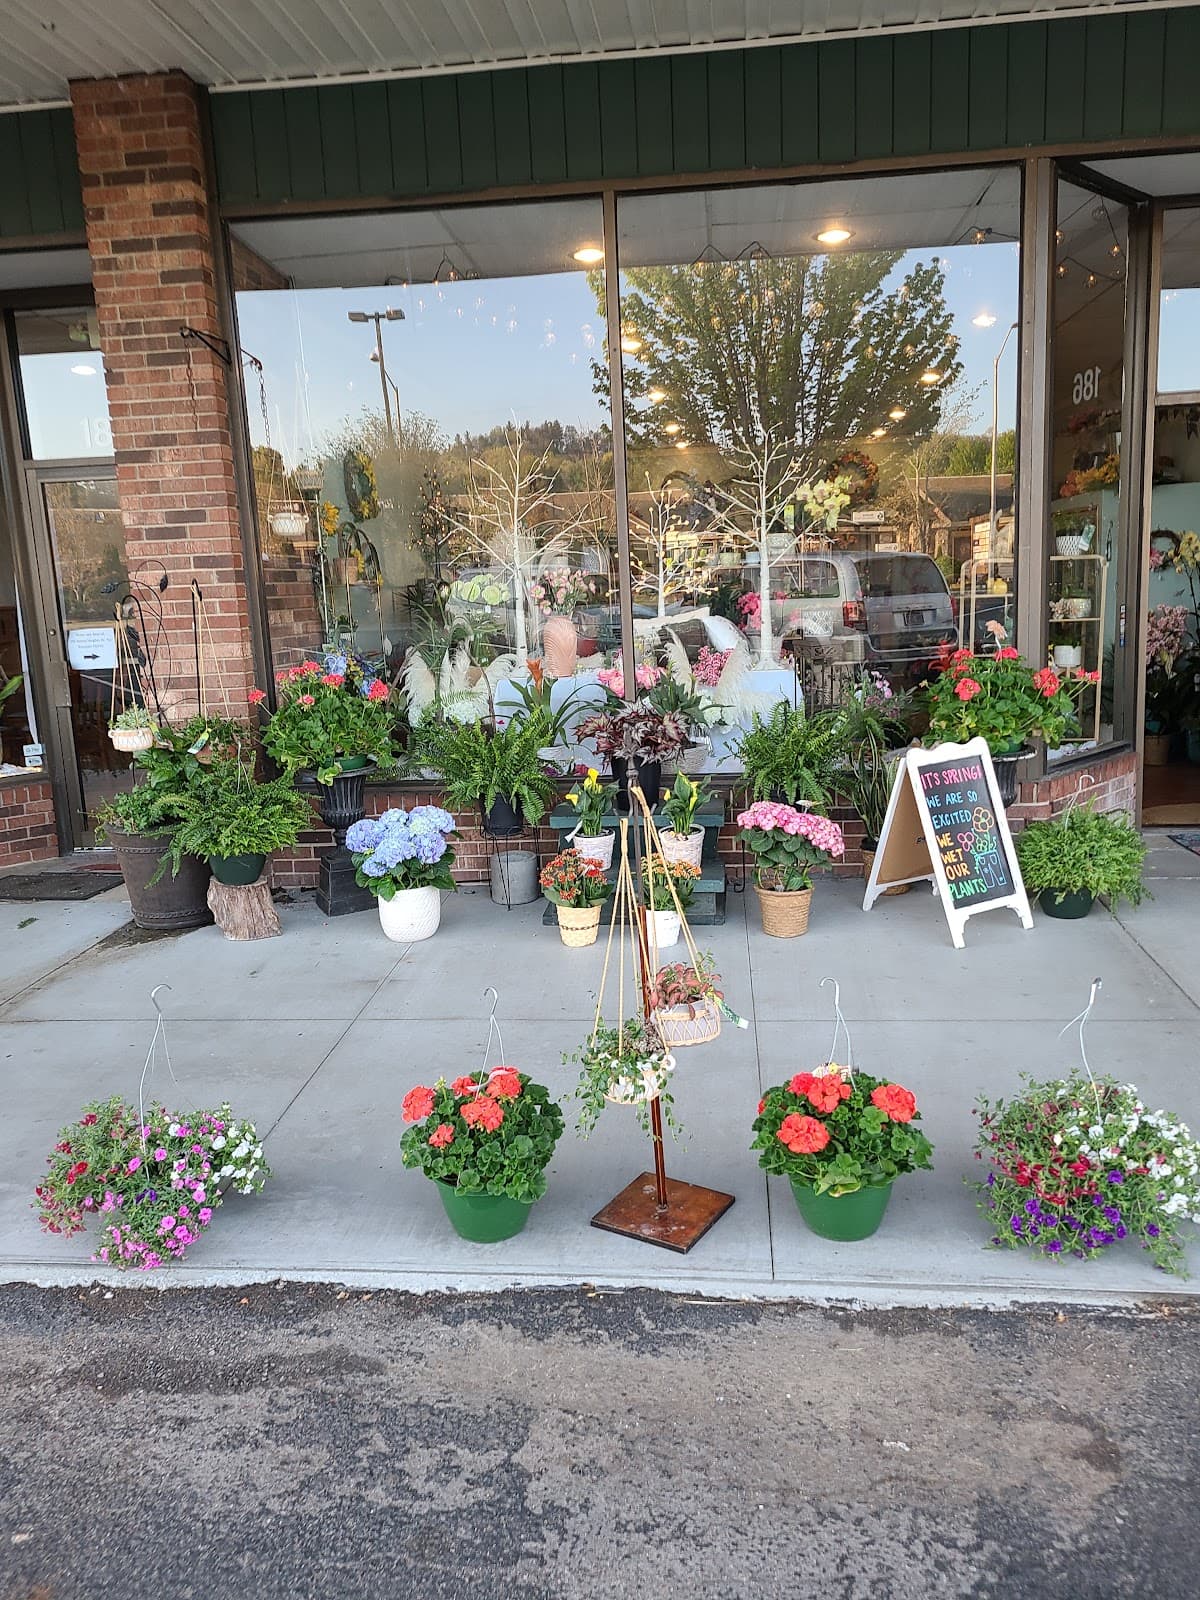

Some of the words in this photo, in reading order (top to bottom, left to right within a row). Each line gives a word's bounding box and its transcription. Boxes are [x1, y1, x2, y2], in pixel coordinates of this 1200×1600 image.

[921, 772, 940, 789] IT'S
[943, 766, 982, 785] SPRING!
[927, 795, 941, 808] WE
[946, 791, 963, 806] ARE
[967, 790, 978, 803] SO
[933, 810, 972, 829] EXCITED
[936, 832, 954, 848] WE
[942, 849, 964, 865] WET
[946, 865, 970, 880] OUR
[949, 879, 987, 901] PLANTS
